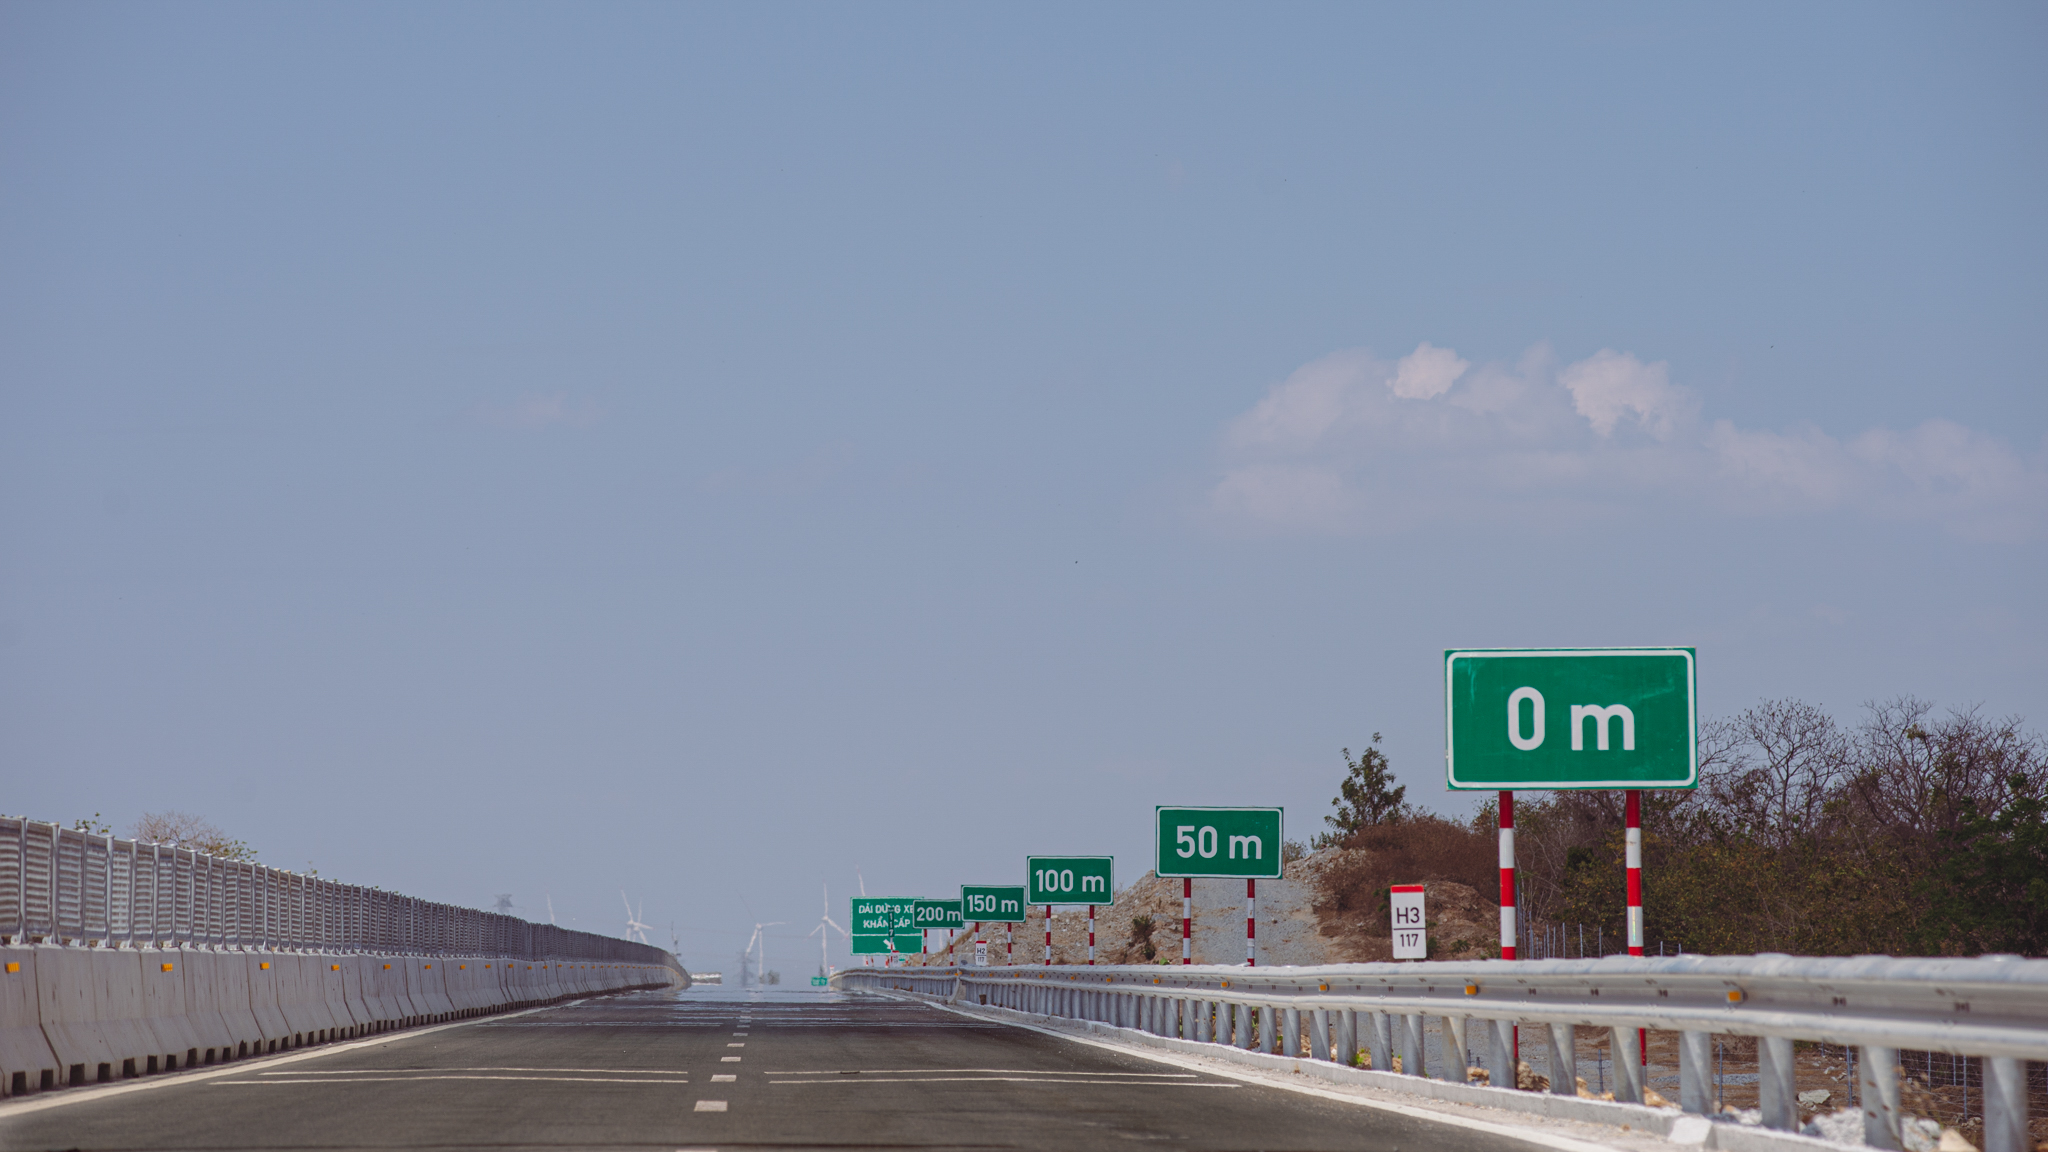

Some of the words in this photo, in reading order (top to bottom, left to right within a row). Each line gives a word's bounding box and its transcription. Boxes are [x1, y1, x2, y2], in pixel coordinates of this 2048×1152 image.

[1507, 686, 1546, 751] 0
[1570, 703, 1635, 751] m
[1176, 825, 1218, 859] 50
[1228, 835, 1262, 860] m
[1035, 869, 1074, 892] 100
[1081, 875, 1105, 893] m
[875, 902, 902, 914] DỪG
[967, 894, 996, 913] 150
[1001, 899, 1019, 913] m
[916, 906, 944, 922] 200
[946, 910, 961, 922] m
[1396, 906, 1421, 924] H3
[1399, 932, 1419, 948] 117
[976, 947, 986, 955] H2
